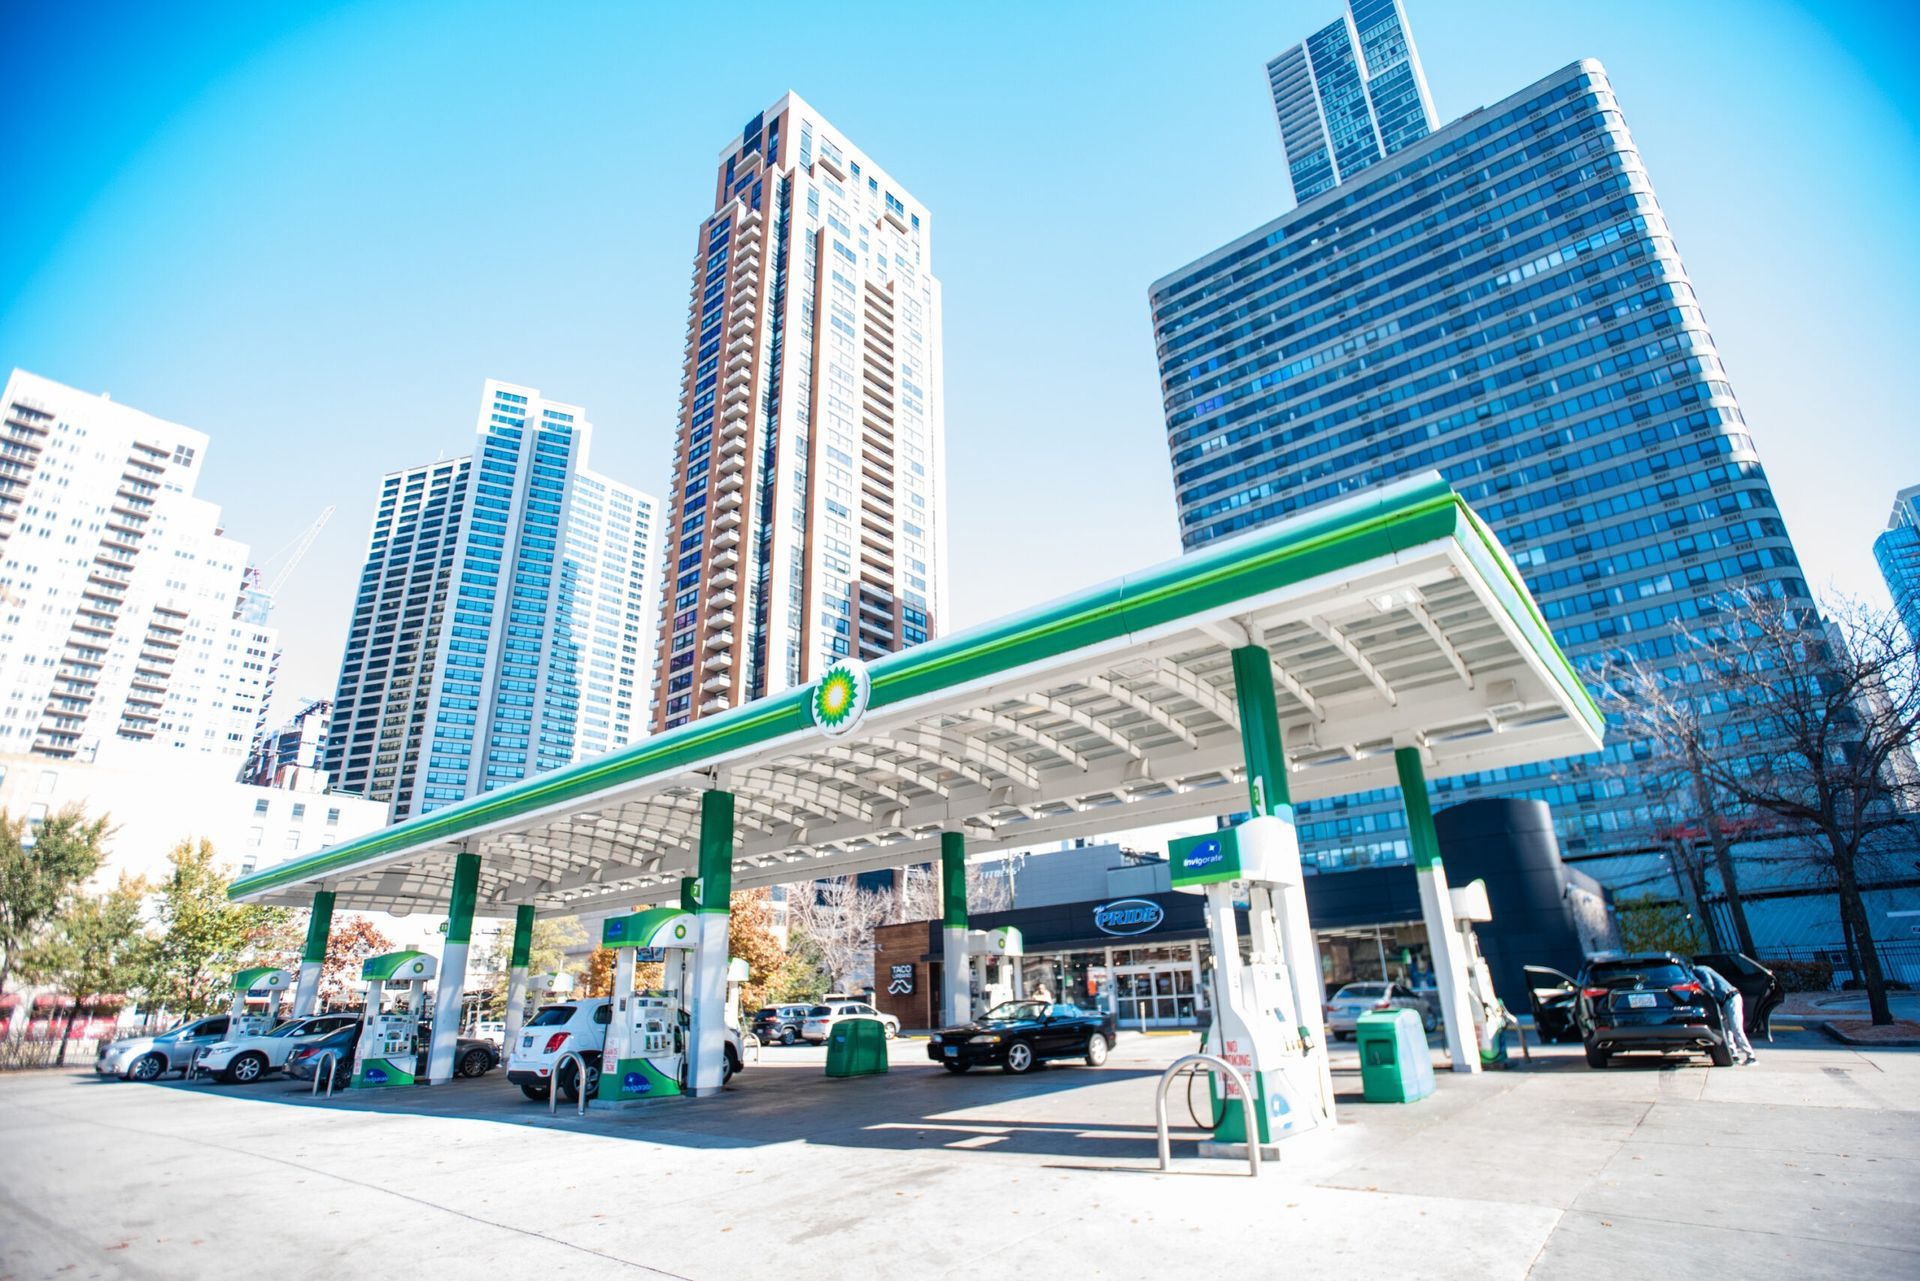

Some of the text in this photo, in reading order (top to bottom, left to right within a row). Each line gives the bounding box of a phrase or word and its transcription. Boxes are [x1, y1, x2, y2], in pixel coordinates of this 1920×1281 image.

[1097, 906, 1159, 927] PRIDE
[891, 964, 912, 974] TACO
[1226, 1040, 1237, 1053] NO
